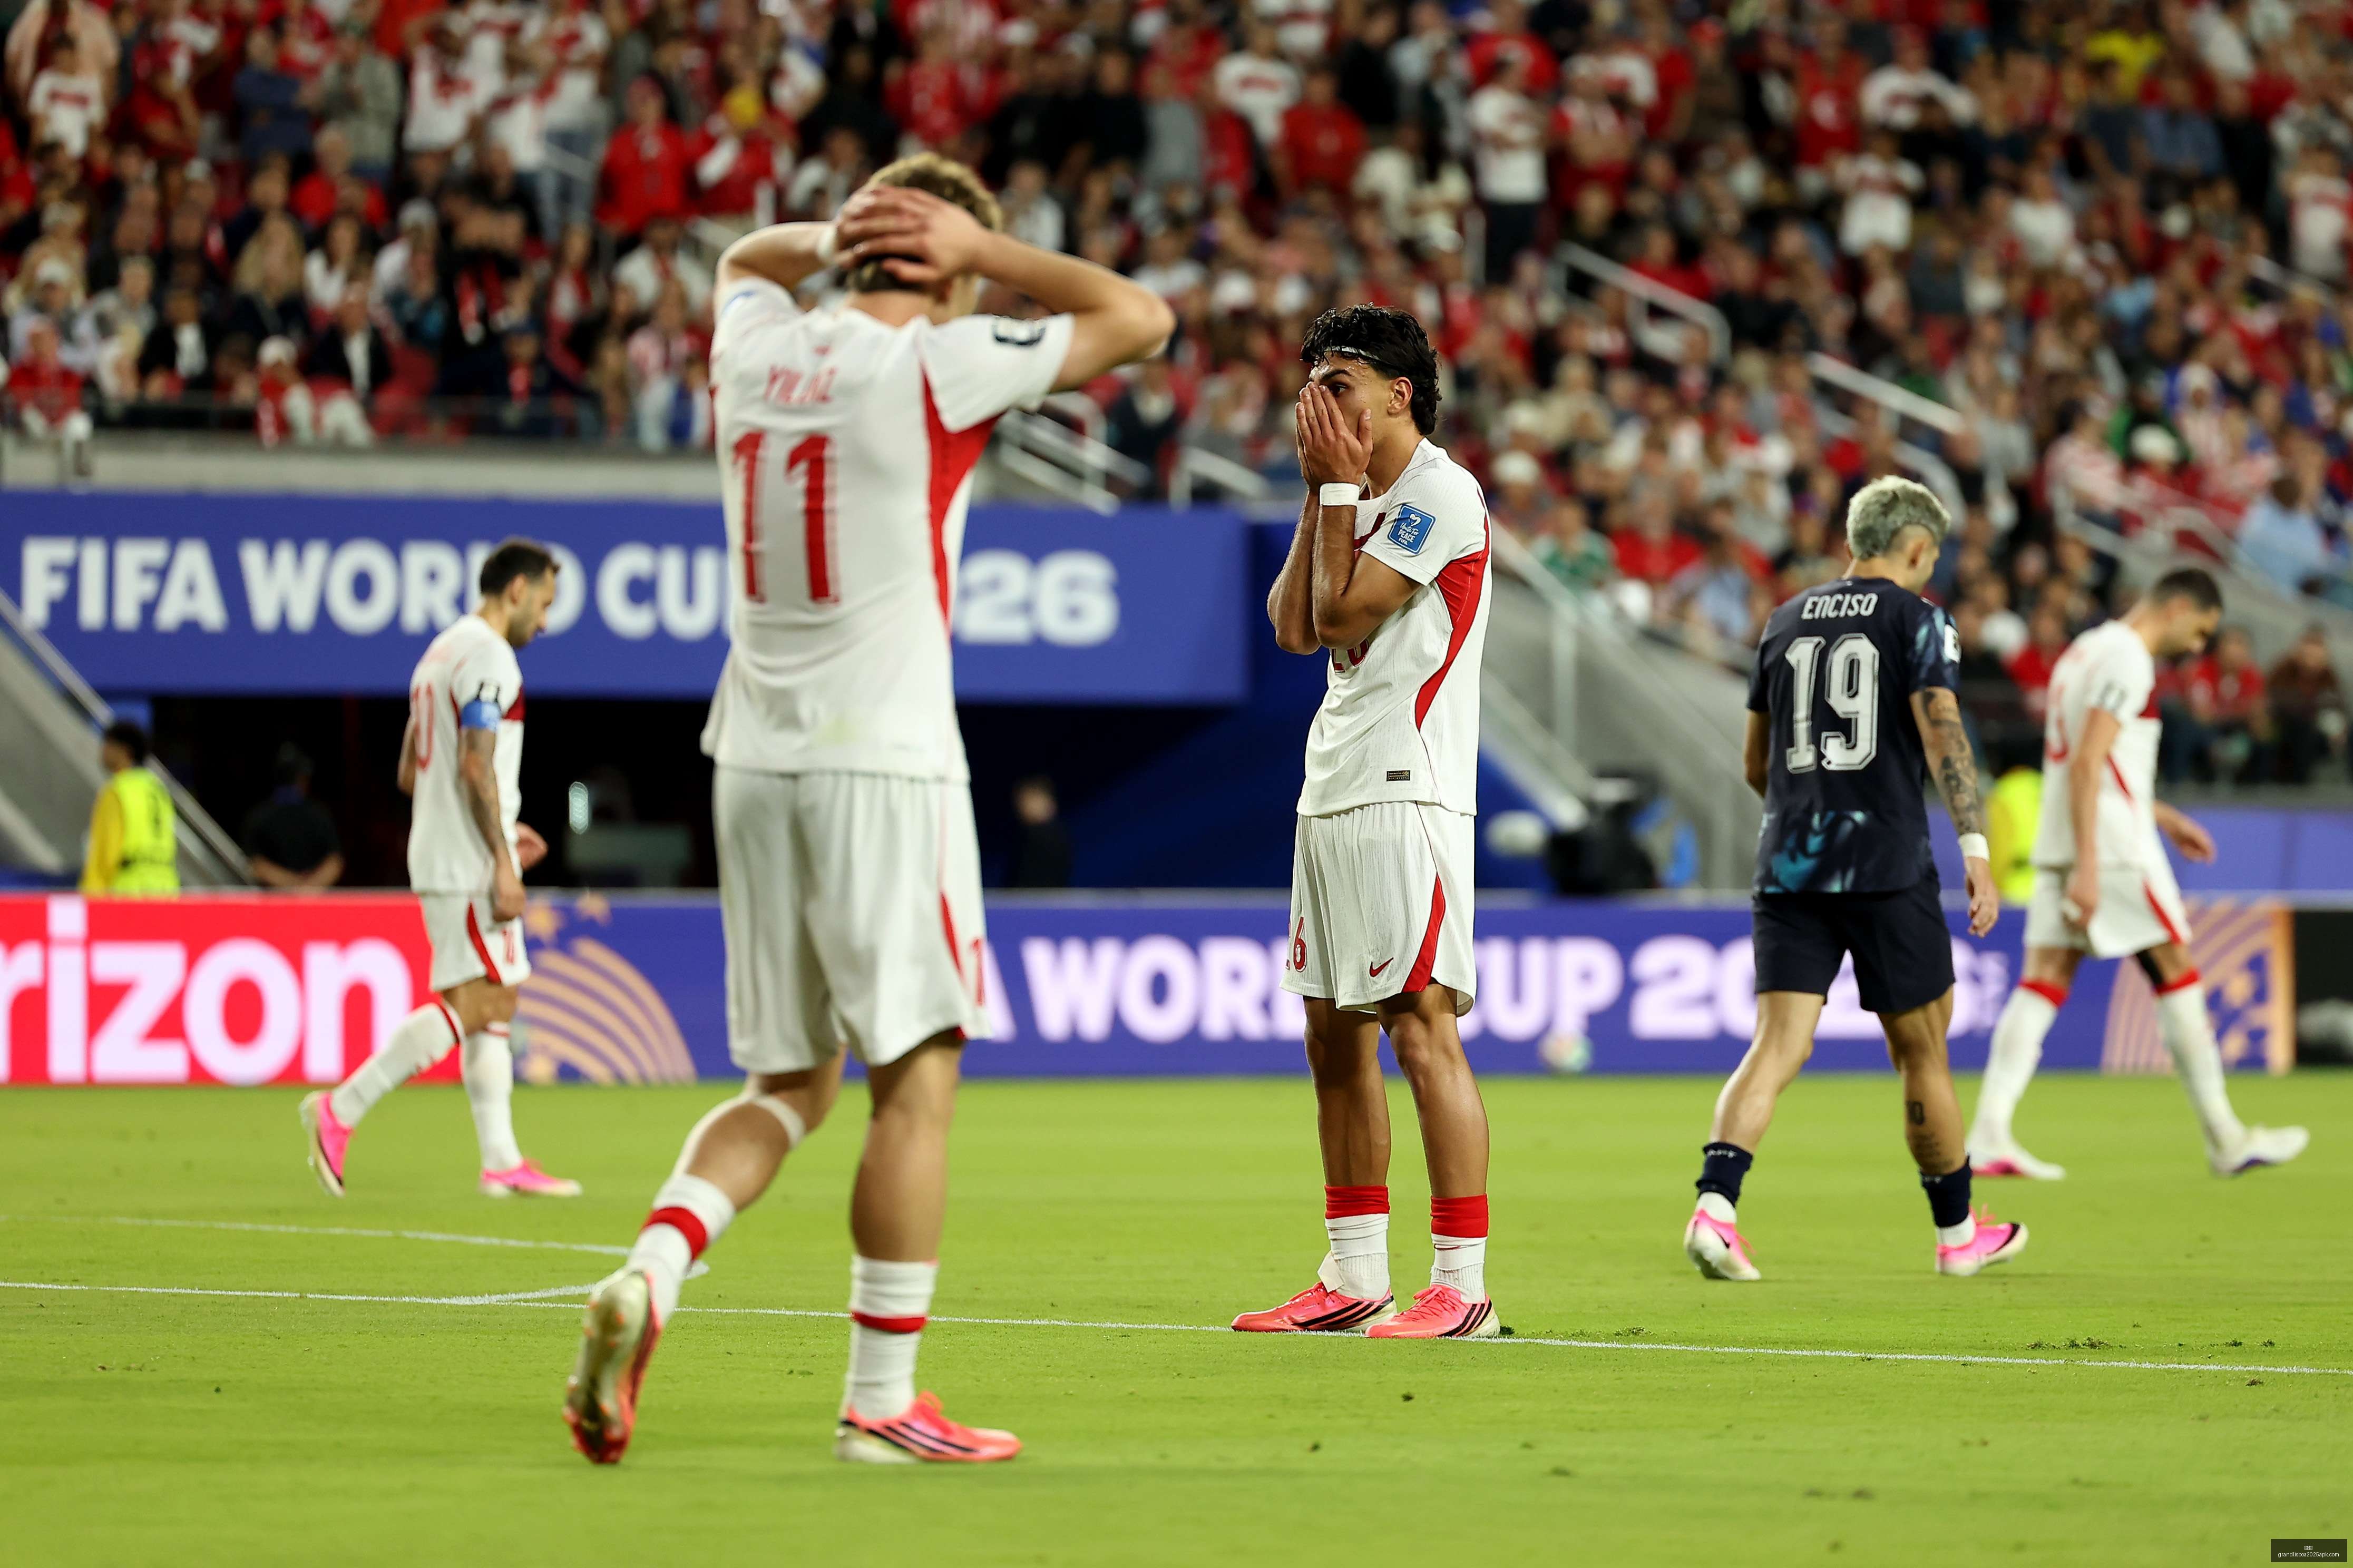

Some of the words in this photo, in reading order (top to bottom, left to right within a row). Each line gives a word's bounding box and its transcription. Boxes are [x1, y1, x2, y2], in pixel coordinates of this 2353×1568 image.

[734, 429, 841, 605] 11
[1398, 529, 1415, 543] PEACE
[22, 536, 229, 633] FIFA
[595, 541, 730, 641] CU
[1801, 592, 1879, 620] ENCISO
[1784, 633, 1880, 773] 19
[1286, 916, 1307, 973] 6
[1456, 934, 1625, 1043] UP
